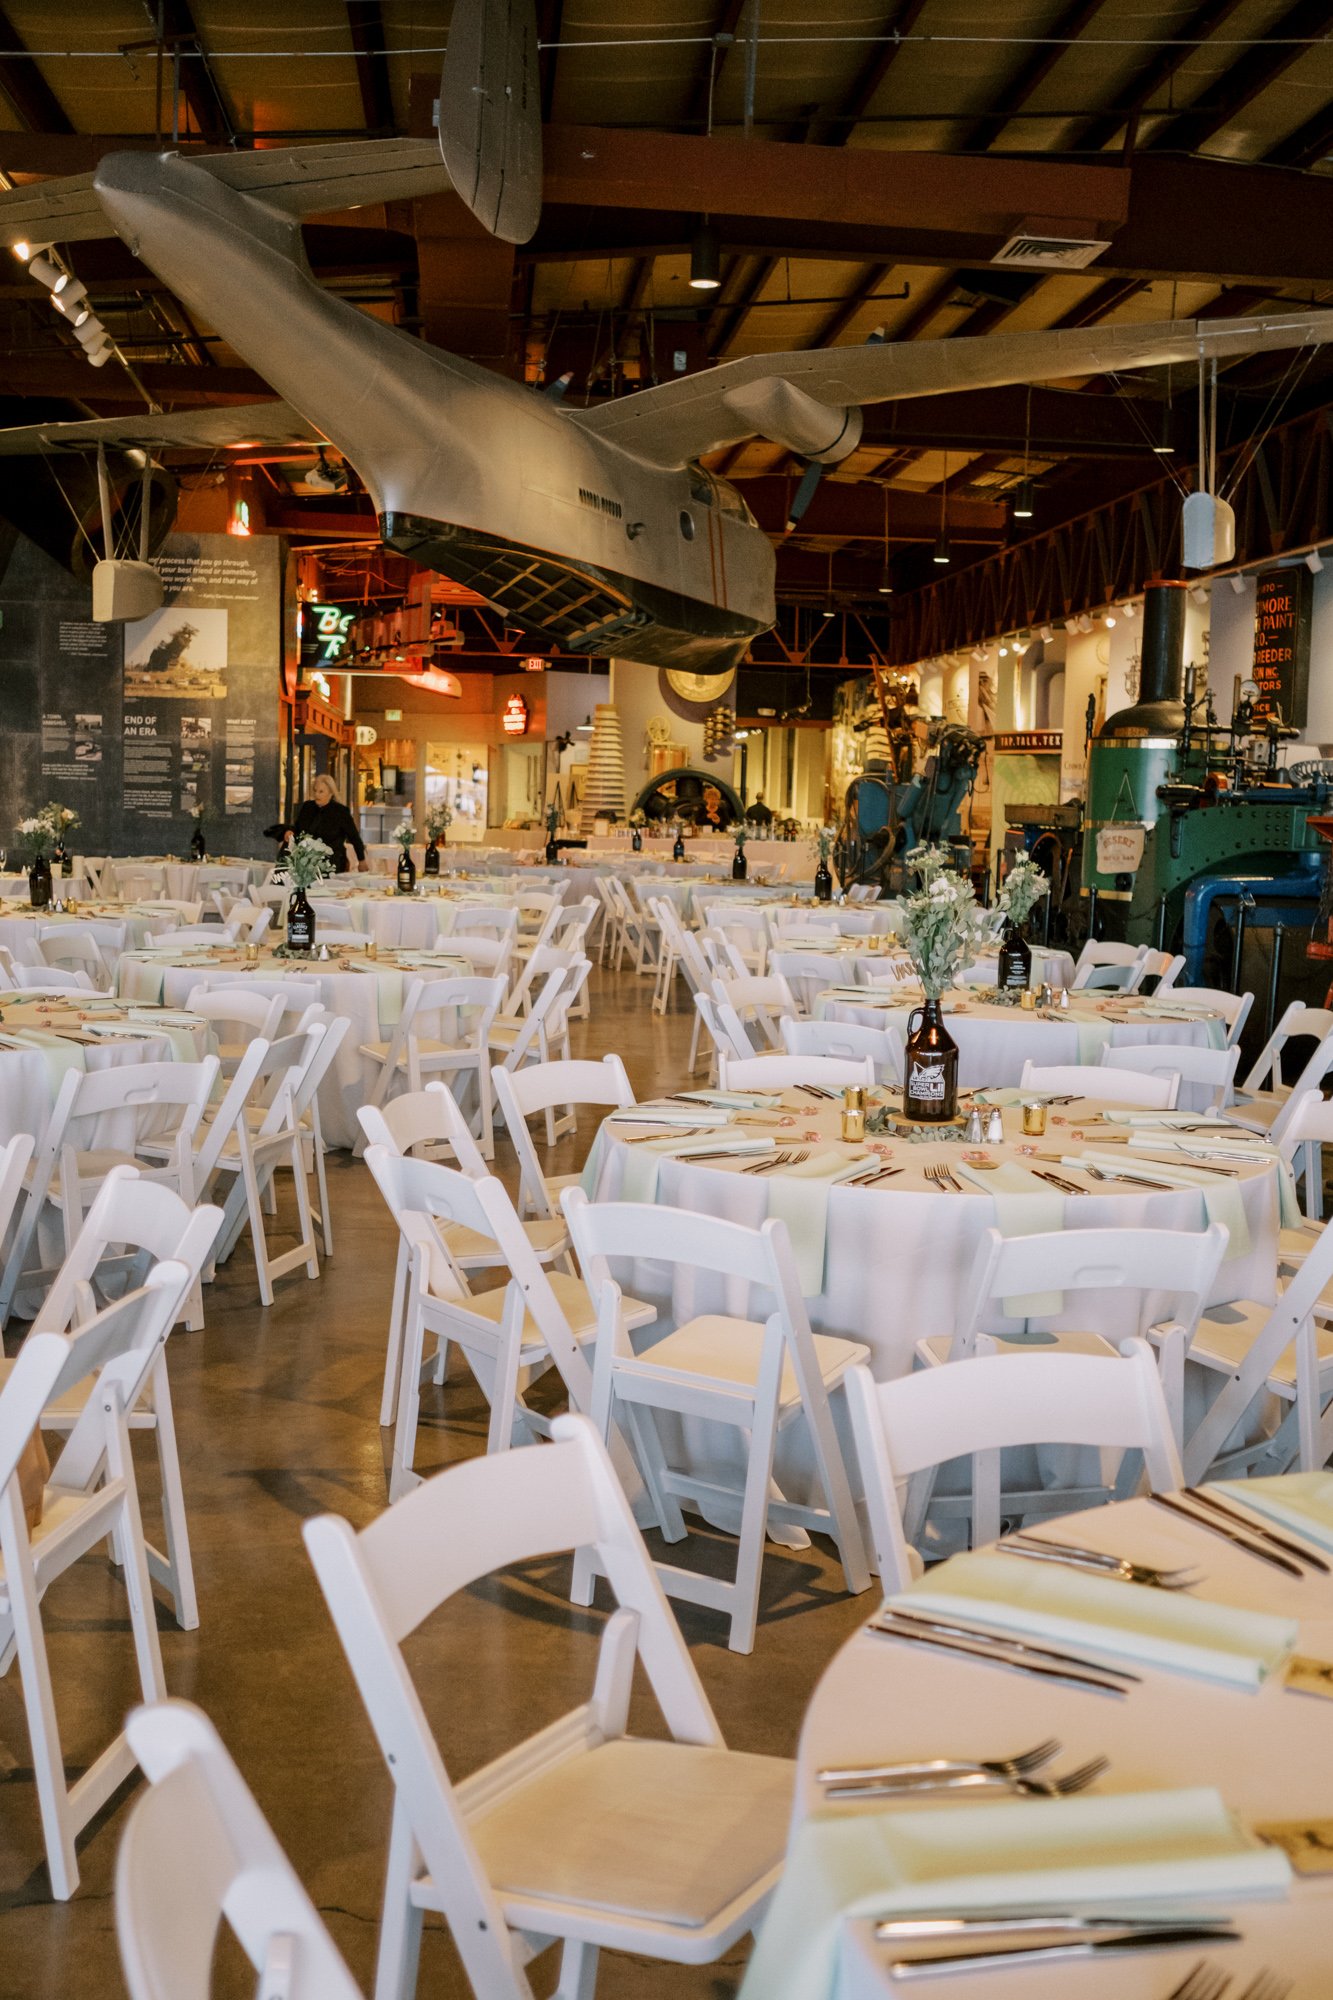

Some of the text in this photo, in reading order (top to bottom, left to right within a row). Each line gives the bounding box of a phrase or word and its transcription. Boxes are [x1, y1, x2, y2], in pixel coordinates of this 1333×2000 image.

[187, 557, 200, 565] that
[193, 567, 213, 575] friend
[1263, 613, 1295, 631] PAINT
[529, 659, 542, 670] EXIT
[124, 715, 158, 725] END OF
[124, 727, 157, 736] AN ERA
